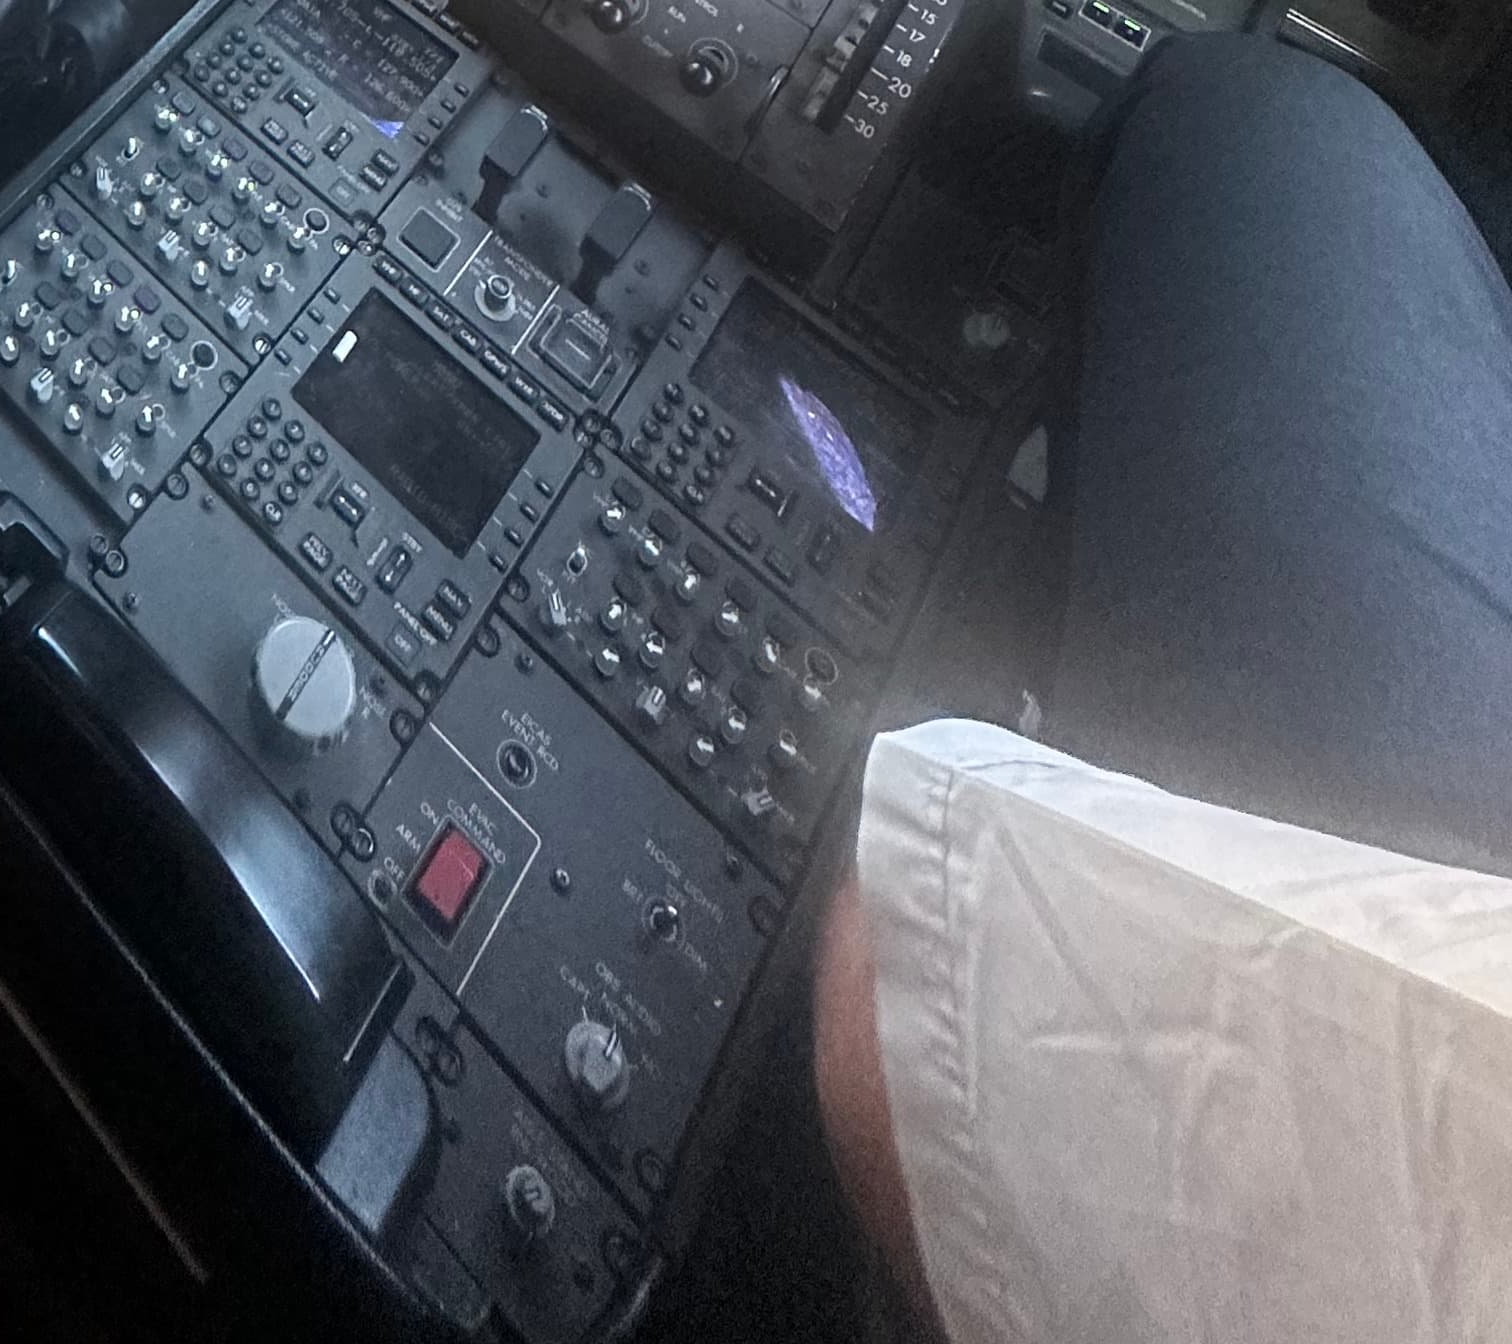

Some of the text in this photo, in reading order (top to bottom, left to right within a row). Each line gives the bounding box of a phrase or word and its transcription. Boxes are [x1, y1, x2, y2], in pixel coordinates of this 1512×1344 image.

[920, 10, 938, 25] 15
[909, 29, 926, 43] 17
[896, 50, 912, 67] 18
[888, 77, 912, 98] 20
[867, 96, 889, 115] 25
[855, 119, 875, 138] 30
[501, 711, 557, 768] EVENT RCD
[522, 714, 552, 744] EICAS
[418, 802, 439, 823] ON
[468, 805, 497, 833] EVAC
[396, 824, 422, 850] ARM
[445, 800, 507, 862] COMMAND
[382, 857, 405, 879] OFF
